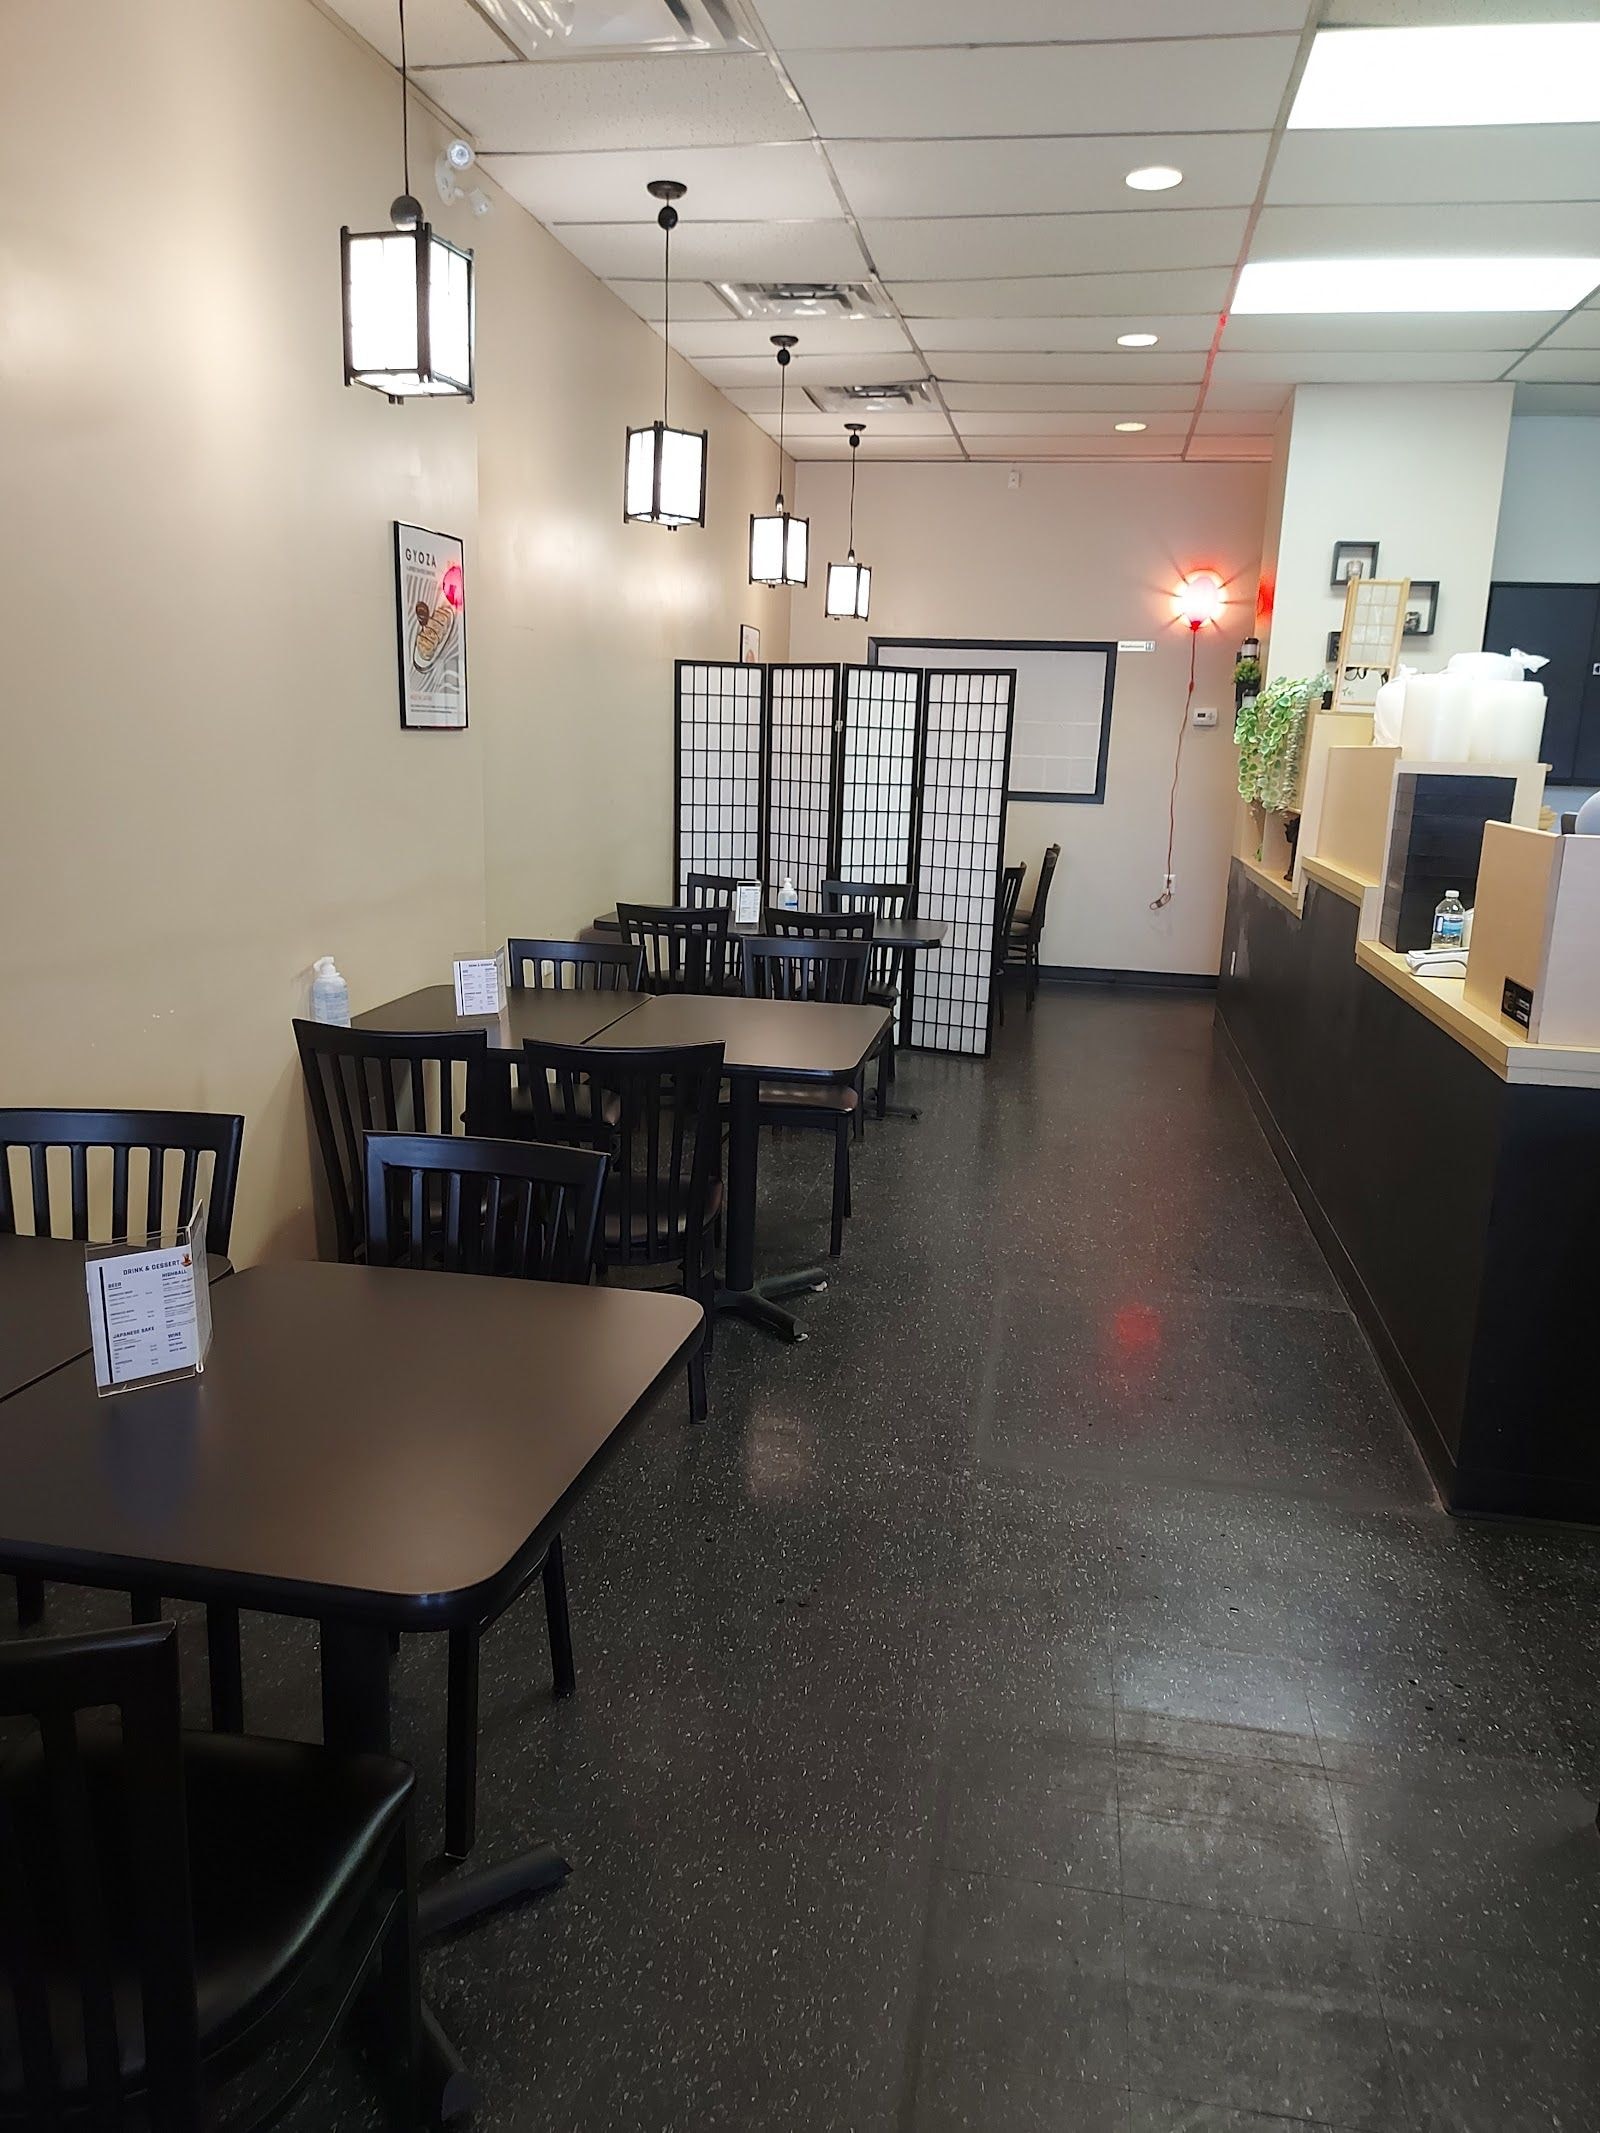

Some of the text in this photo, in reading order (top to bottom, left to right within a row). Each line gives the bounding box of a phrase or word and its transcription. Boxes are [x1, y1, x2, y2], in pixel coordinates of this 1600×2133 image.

[405, 548, 437, 568] GYOZA
[123, 1266, 144, 1276] DRINK
[151, 1260, 180, 1270] DESSERT
[113, 1329, 140, 1338] JAPANESE
